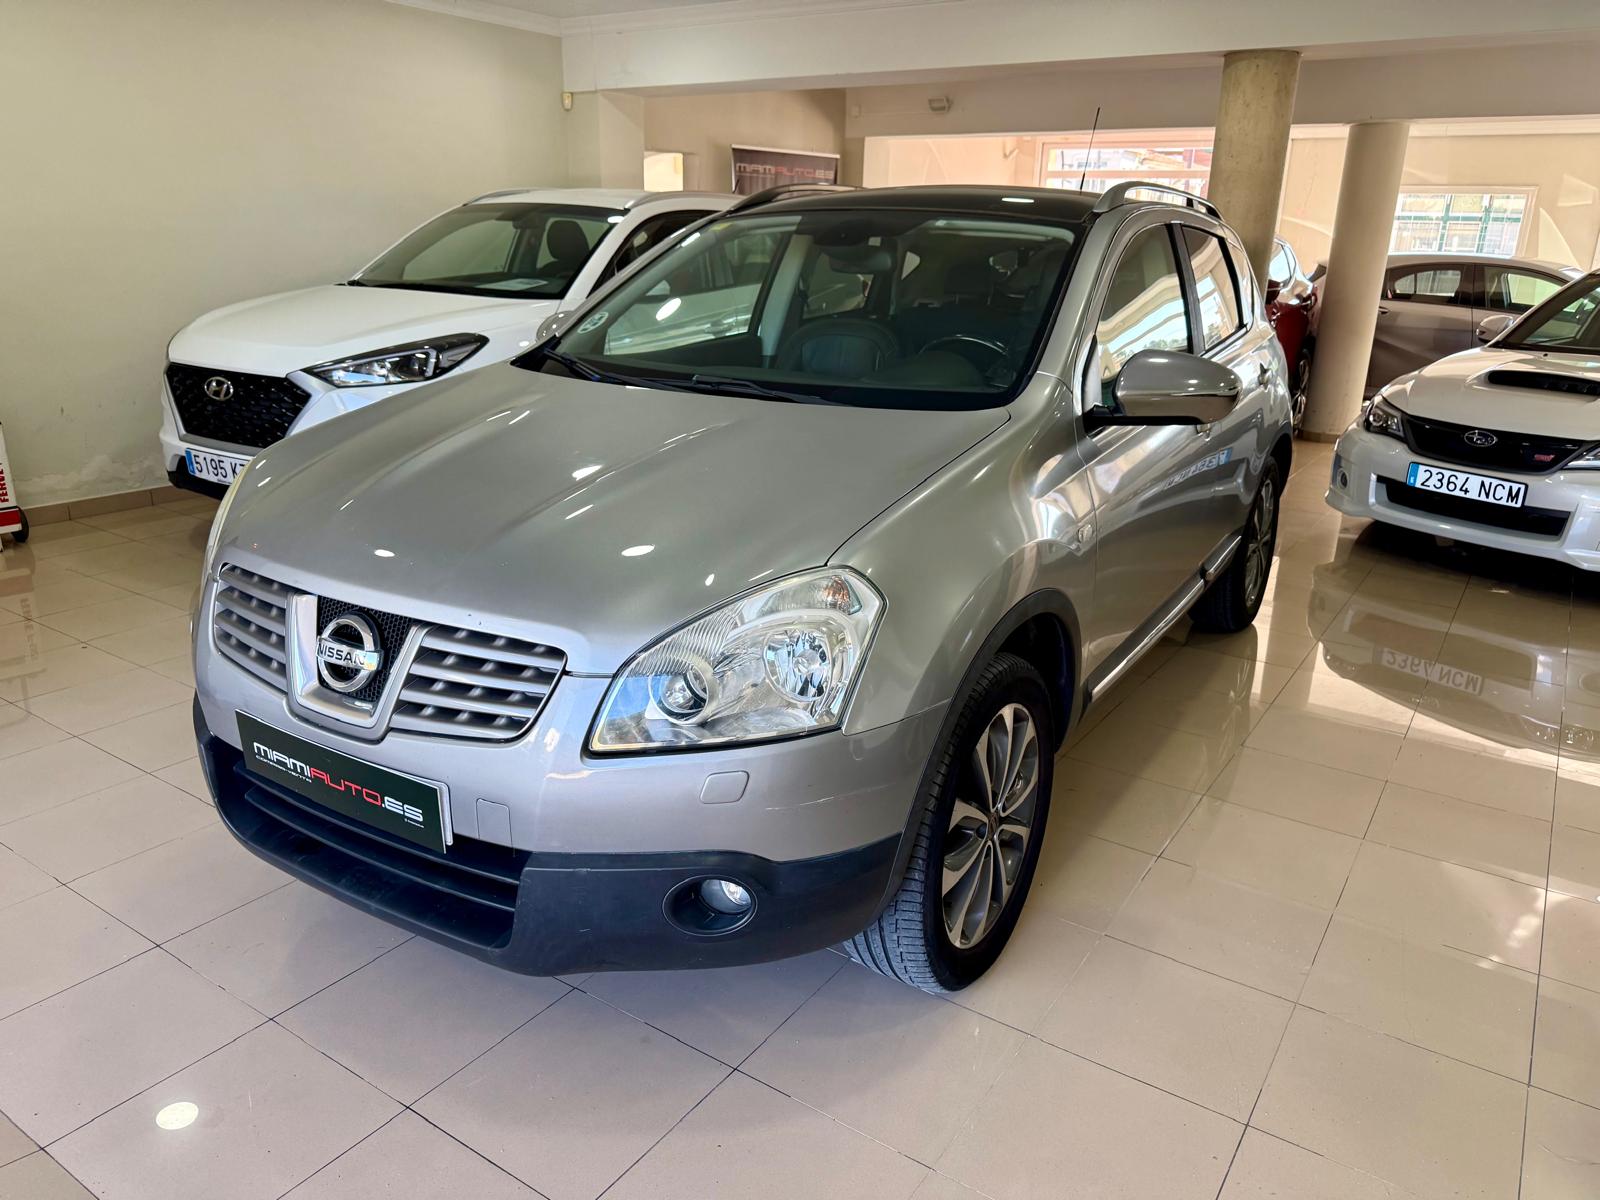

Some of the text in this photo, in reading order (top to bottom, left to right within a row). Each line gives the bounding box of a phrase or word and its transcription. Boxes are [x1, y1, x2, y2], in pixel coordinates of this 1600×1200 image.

[193, 455, 245, 479] 5195 K
[1420, 469, 1521, 505] 2364 NCM
[253, 742, 424, 822] MIAMIAUTO.ES
